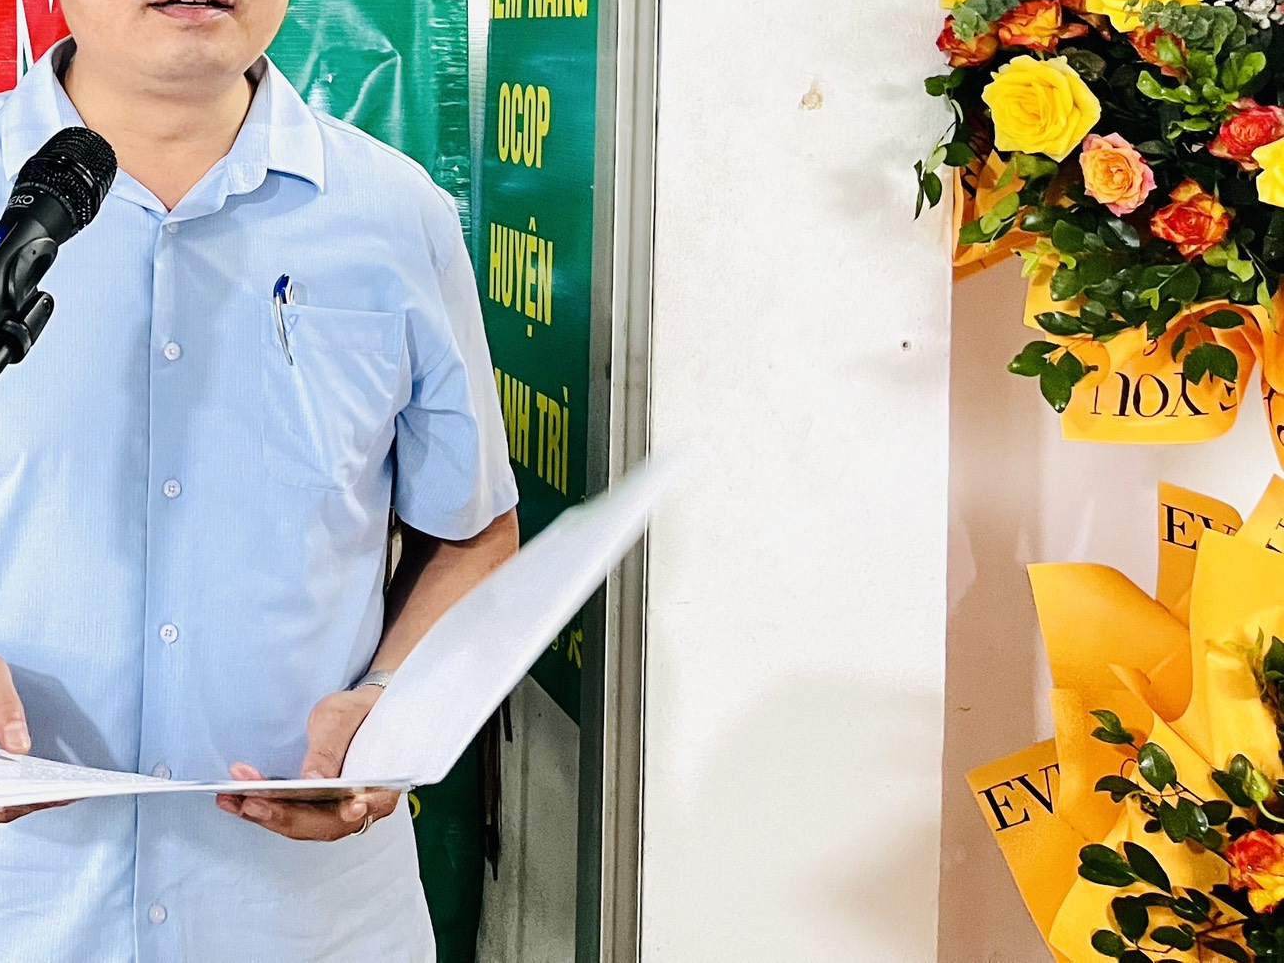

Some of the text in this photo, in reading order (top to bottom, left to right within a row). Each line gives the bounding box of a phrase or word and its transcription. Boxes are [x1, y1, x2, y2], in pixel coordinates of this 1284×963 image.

[497, 81, 551, 168] OCOP
[488, 216, 554, 338] HUYỆN
[536, 385, 569, 497] TRÌ
